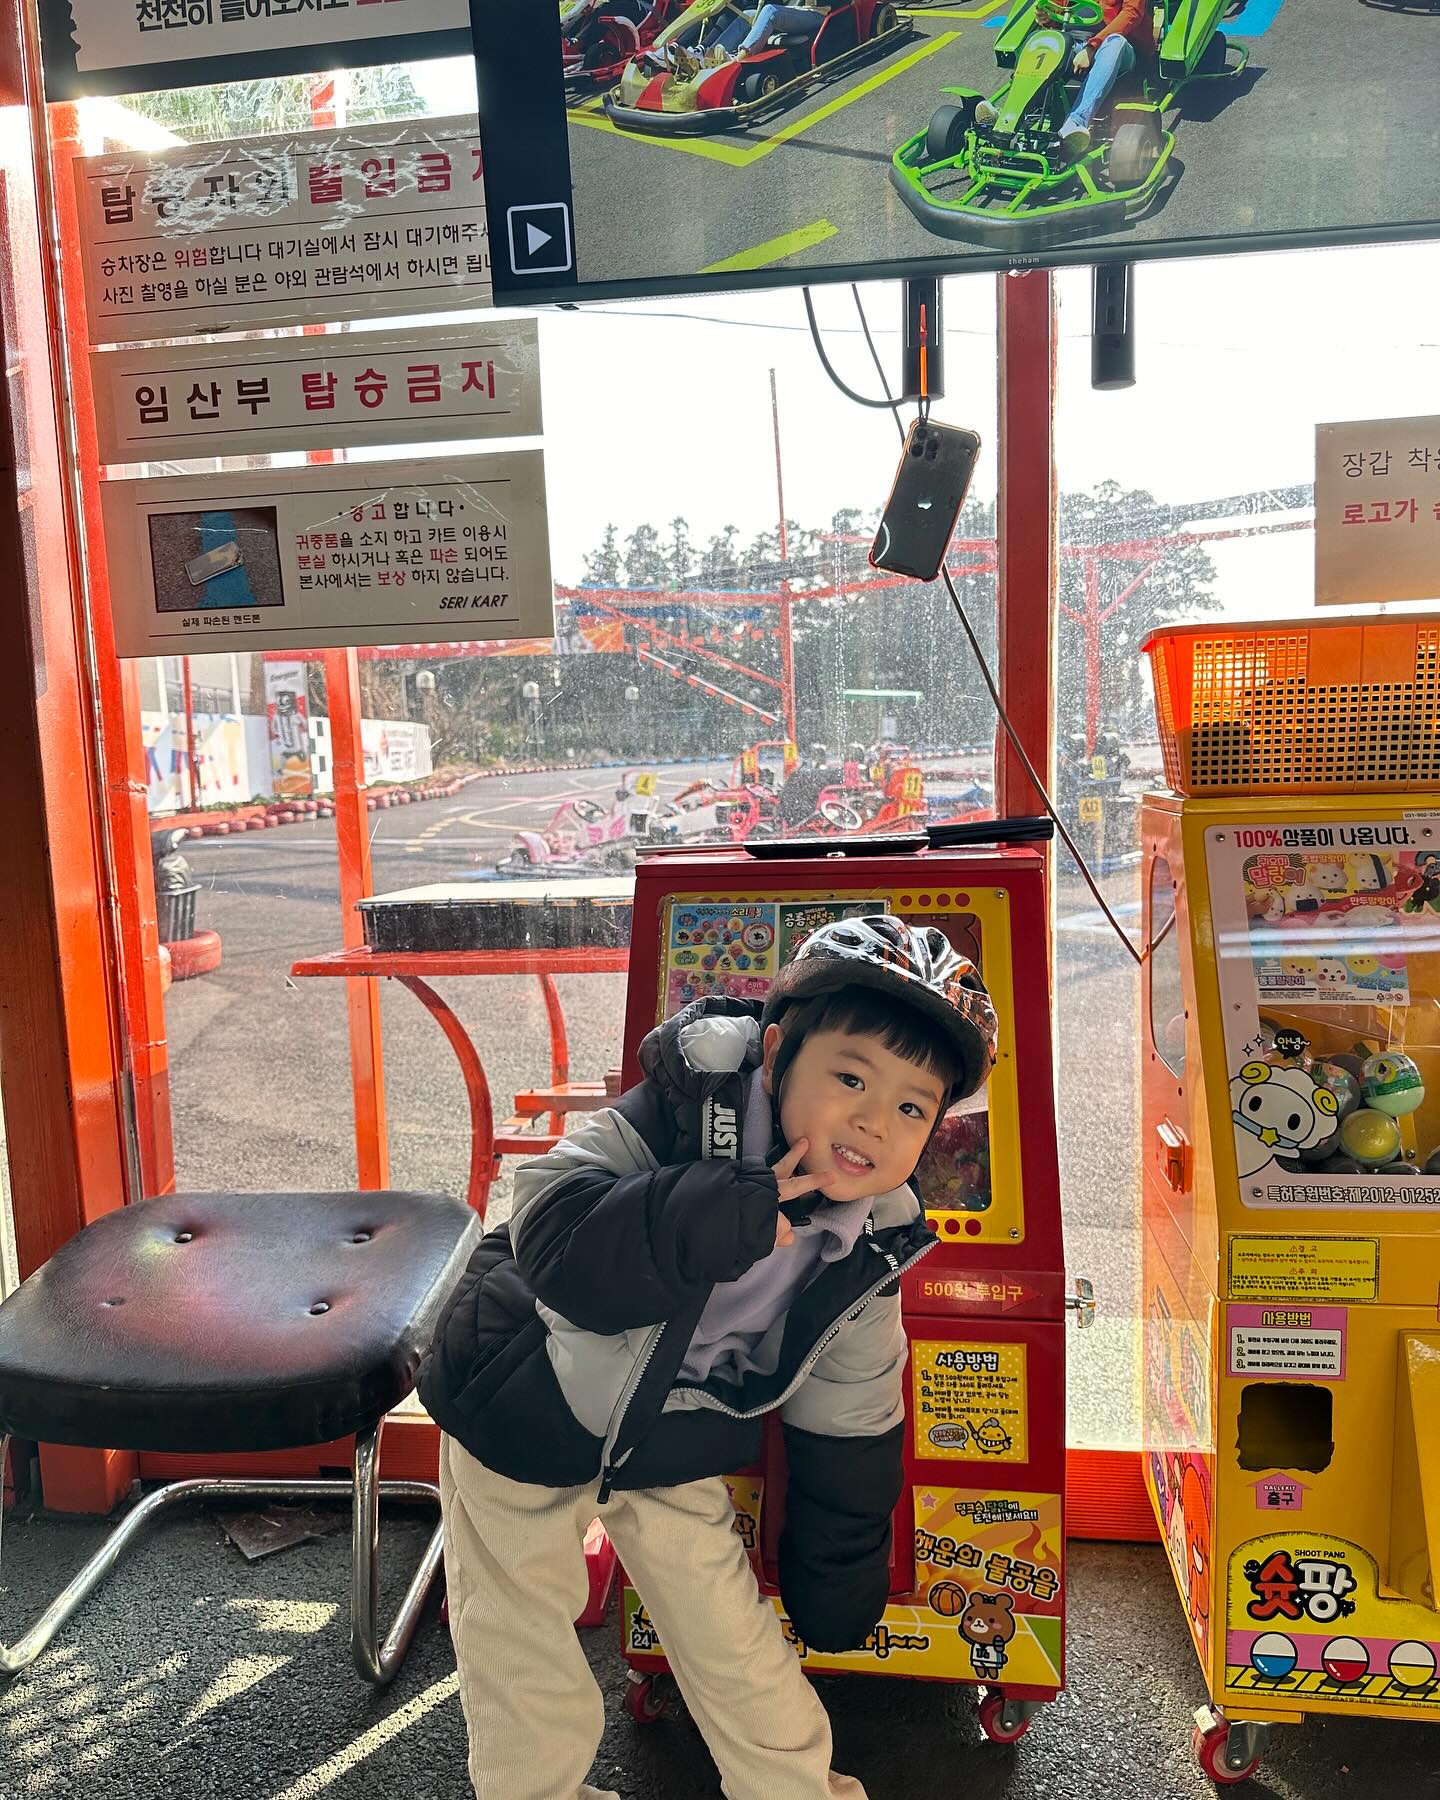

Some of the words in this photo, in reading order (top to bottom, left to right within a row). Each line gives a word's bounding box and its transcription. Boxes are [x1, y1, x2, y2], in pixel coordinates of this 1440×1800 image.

[101, 251, 167, 277] 승차장은
[174, 243, 262, 269] 위험합니다
[268, 234, 356, 260] 대기실에서
[363, 230, 398, 251] 잠시
[103, 286, 134, 304] 사진
[141, 280, 189, 302] 촬영을
[195, 277, 228, 296] 하실
[235, 272, 268, 293] 분은
[275, 268, 307, 289] 야외
[314, 262, 400, 287] 관람석에서
[407, 256, 458, 278] 하시면
[135, 377, 271, 424] 임산부
[301, 360, 496, 411] 탑승금지
[1342, 450, 1393, 478] 장갑
[1342, 498, 1419, 525] 로고가
[296, 531, 353, 550] 귀중품을
[359, 531, 388, 547] 소지
[394, 529, 422, 545] 하고
[428, 527, 457, 543] 카트
[463, 525, 507, 542] 이용시
[298, 553, 326, 570] 분실
[332, 552, 390, 567] 하시거나
[395, 549, 424, 565] 혹은
[430, 548, 459, 564] 파손
[464, 545, 509, 562] 되어도
[299, 573, 372, 590] 본사에서는
[377, 571, 406, 587] 보상
[412, 569, 440, 584] 하지
[446, 566, 509, 583] 않습니다.
[439, 595, 469, 609] SERI
[471, 594, 509, 608] KART
[182, 617, 200, 628] 실제
[203, 615, 230, 627] 파손된
[1339, 826, 1416, 847] 나옵니다.
[713, 1102, 738, 1160] JUST
[864, 1218, 874, 1237] NIKE
[883, 1253, 900, 1271] NIKE
[923, 1282, 969, 1298] 500원
[976, 1282, 1024, 1301] 투입구
[1262, 1310, 1312, 1327] 사용방법
[935, 1350, 999, 1372] 사용방법
[1267, 1491, 1295, 1506] 출구
[915, 1529, 983, 1568] 행운의
[985, 1553, 1060, 1601] 불공을
[1294, 1549, 1322, 1557] SHOOT
[1323, 1550, 1346, 1559] PANG
[633, 1633, 650, 1648] 24
